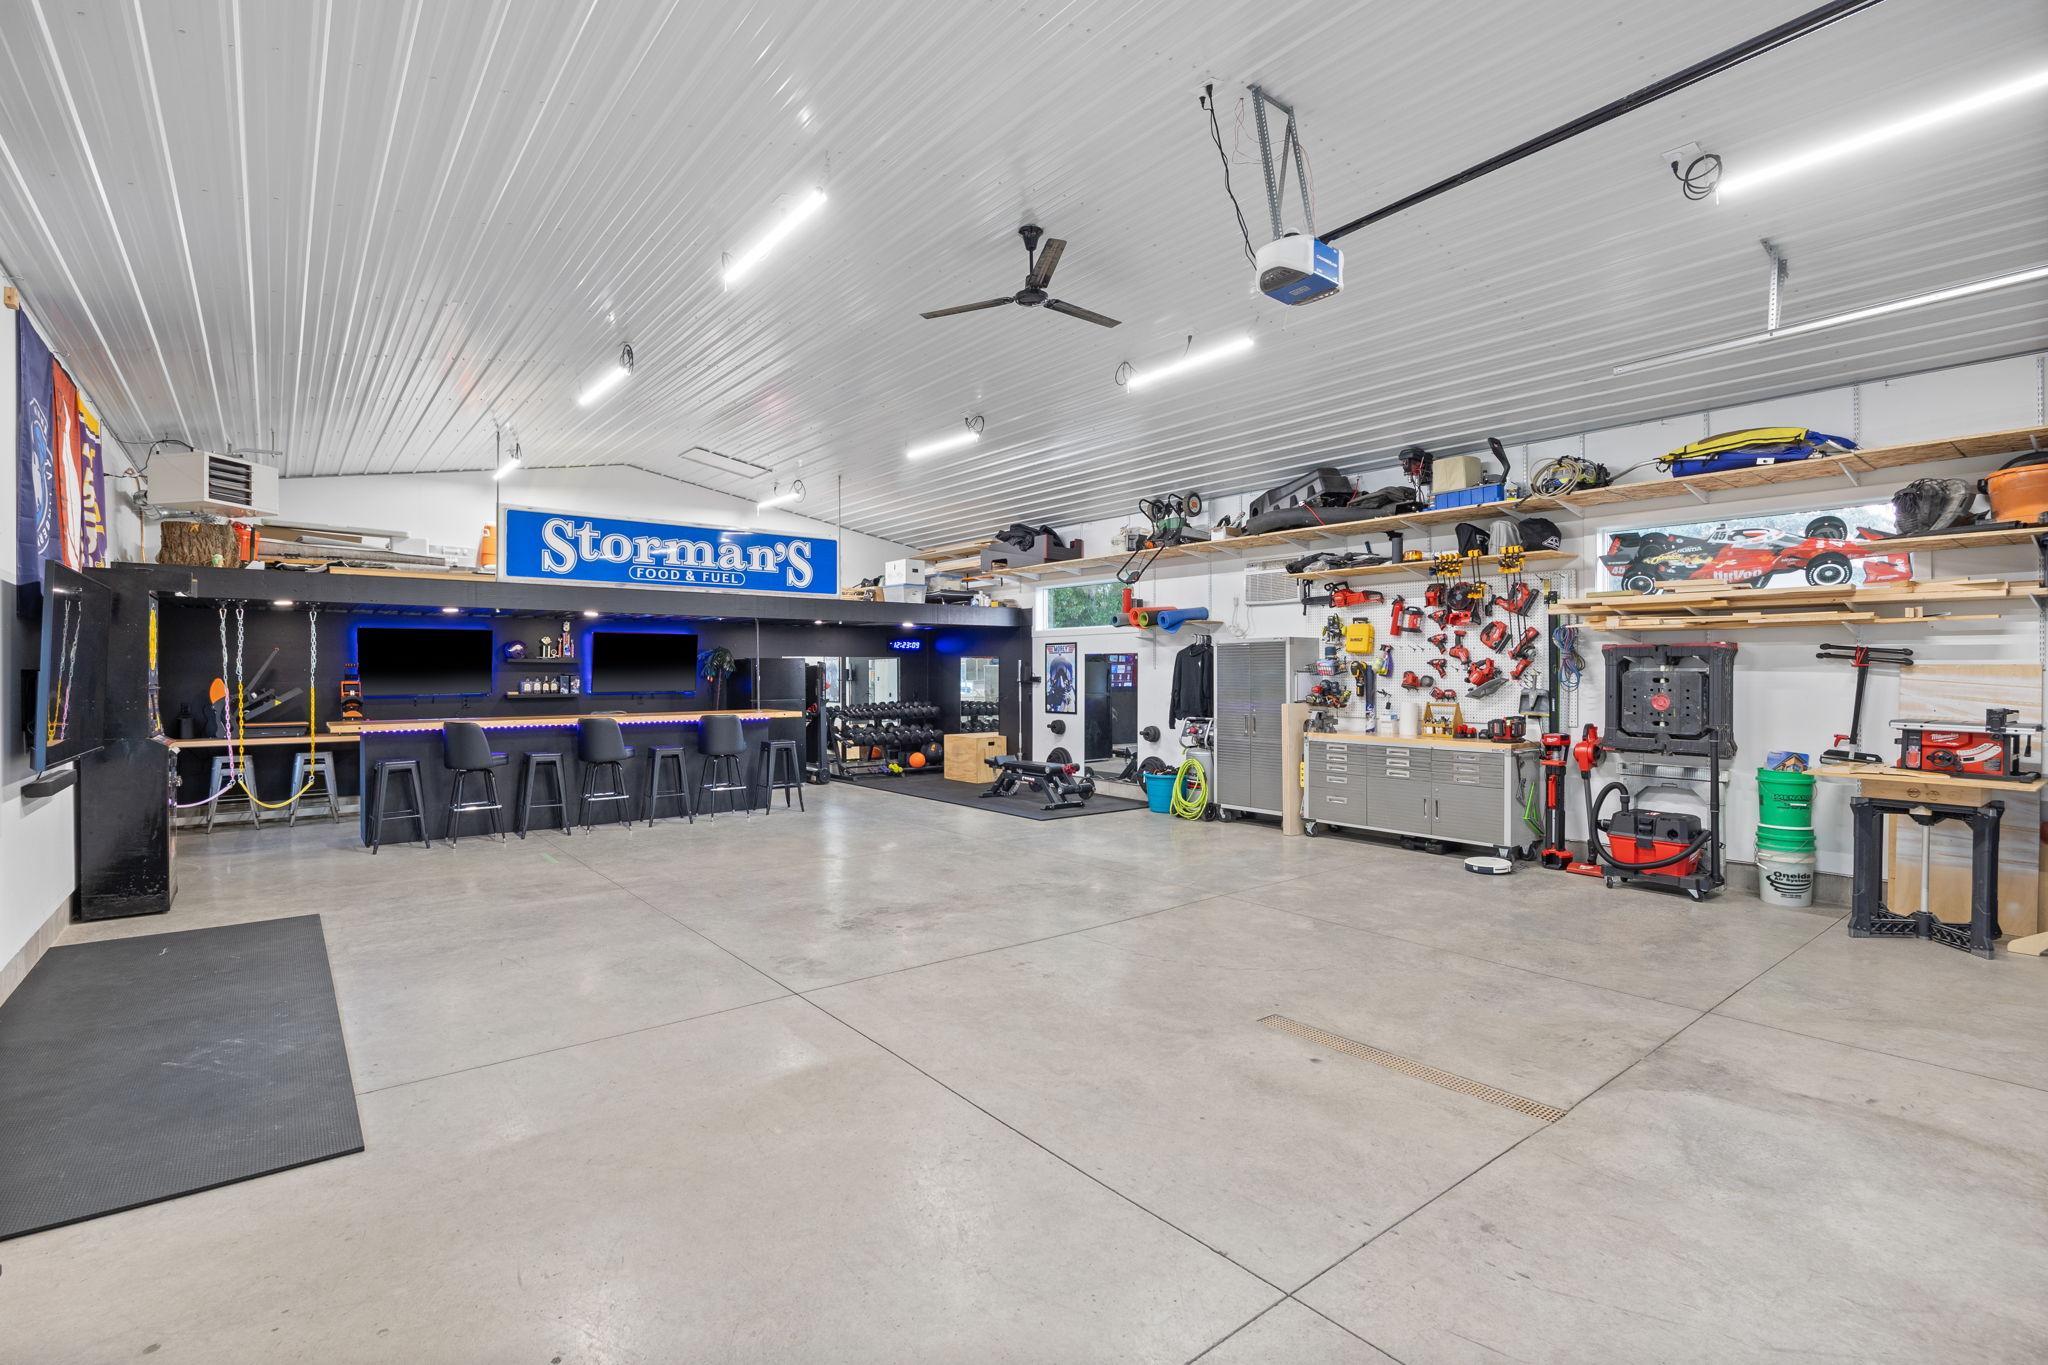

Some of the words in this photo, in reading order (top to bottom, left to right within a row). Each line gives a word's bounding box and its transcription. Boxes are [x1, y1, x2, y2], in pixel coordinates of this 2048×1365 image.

[1712, 531, 1727, 541] 45
[636, 567, 680, 581] FOOD
[685, 570, 696, 582] &
[702, 571, 739, 584] FUEL
[893, 641, 920, 649] 12:23:09
[1773, 871, 1811, 880] Oneida
